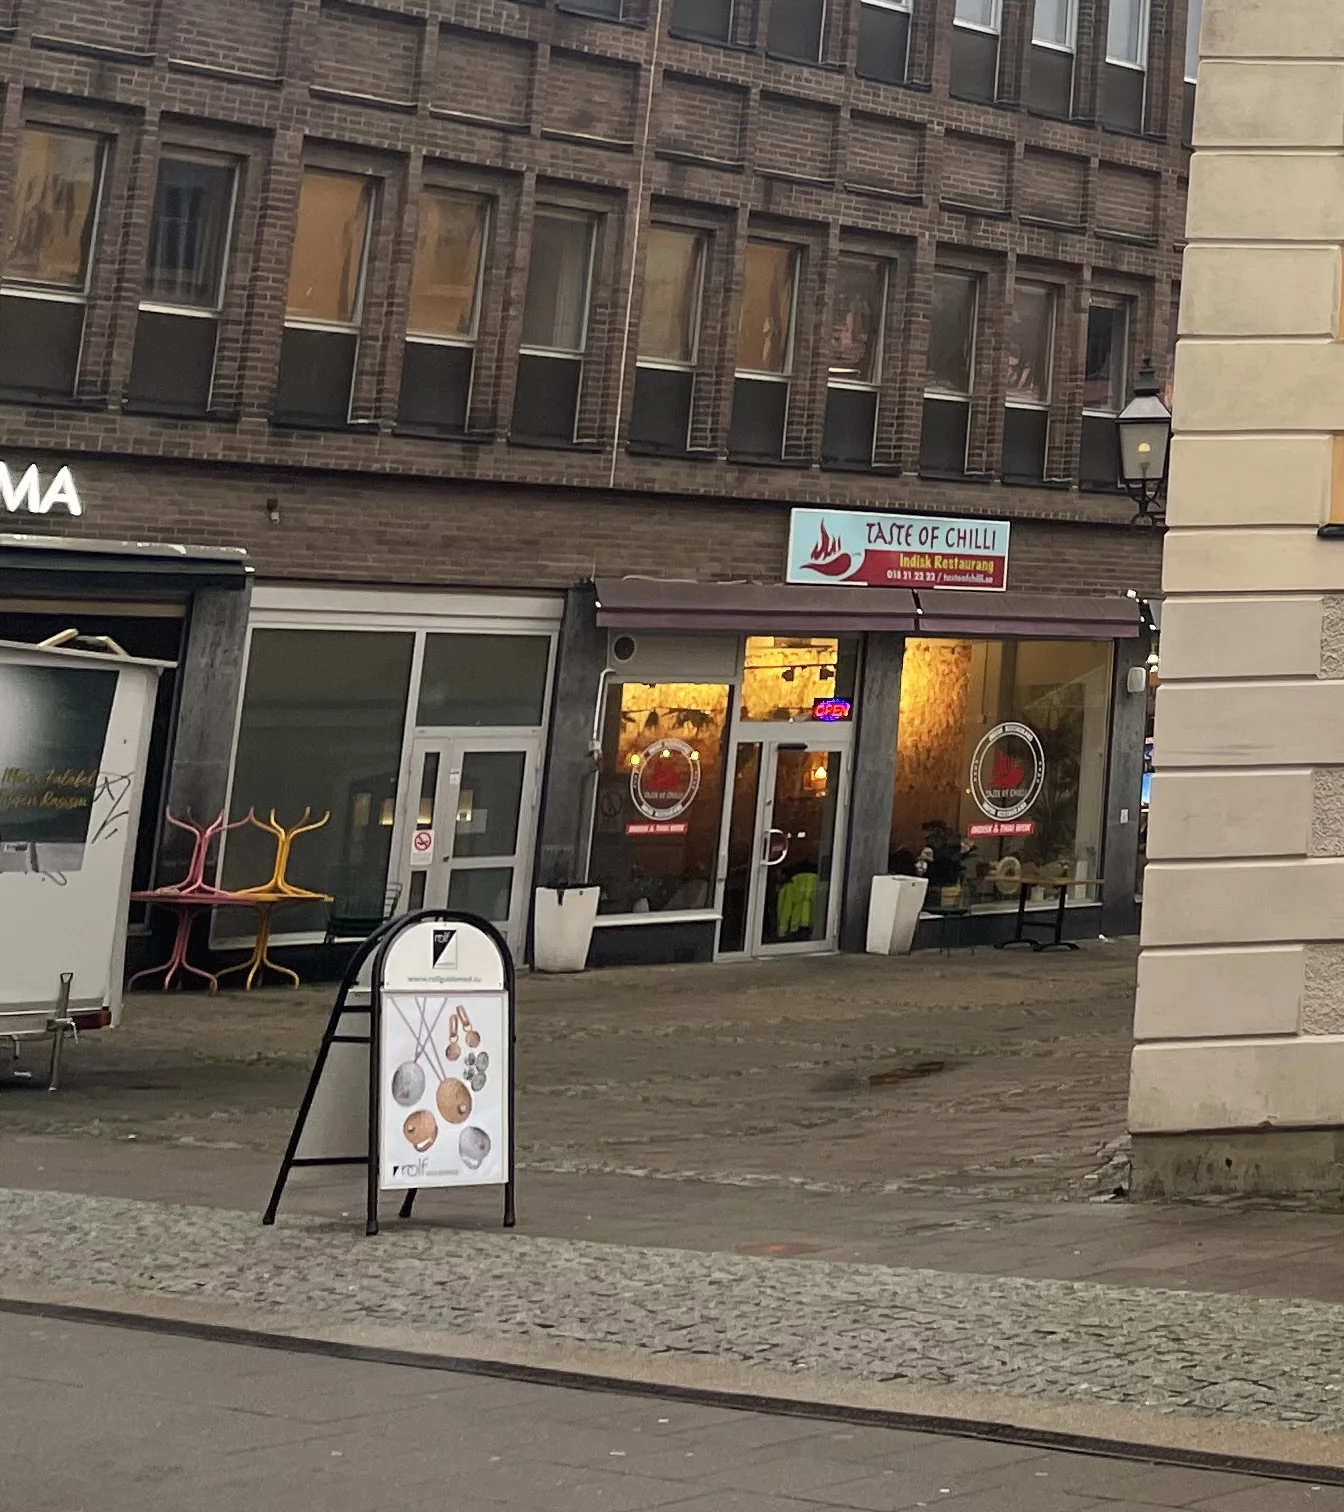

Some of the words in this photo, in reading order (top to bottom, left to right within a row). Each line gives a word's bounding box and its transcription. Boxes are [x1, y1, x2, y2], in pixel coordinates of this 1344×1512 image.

[0, 461, 82, 516] MA
[866, 521, 914, 547] TASTE
[919, 526, 940, 549] OF
[945, 527, 996, 551] CHILLI
[899, 552, 931, 569] Indisk
[934, 556, 994, 573] Restaurang
[815, 703, 850, 717] OPEN
[401, 1157, 428, 1177] rolf
